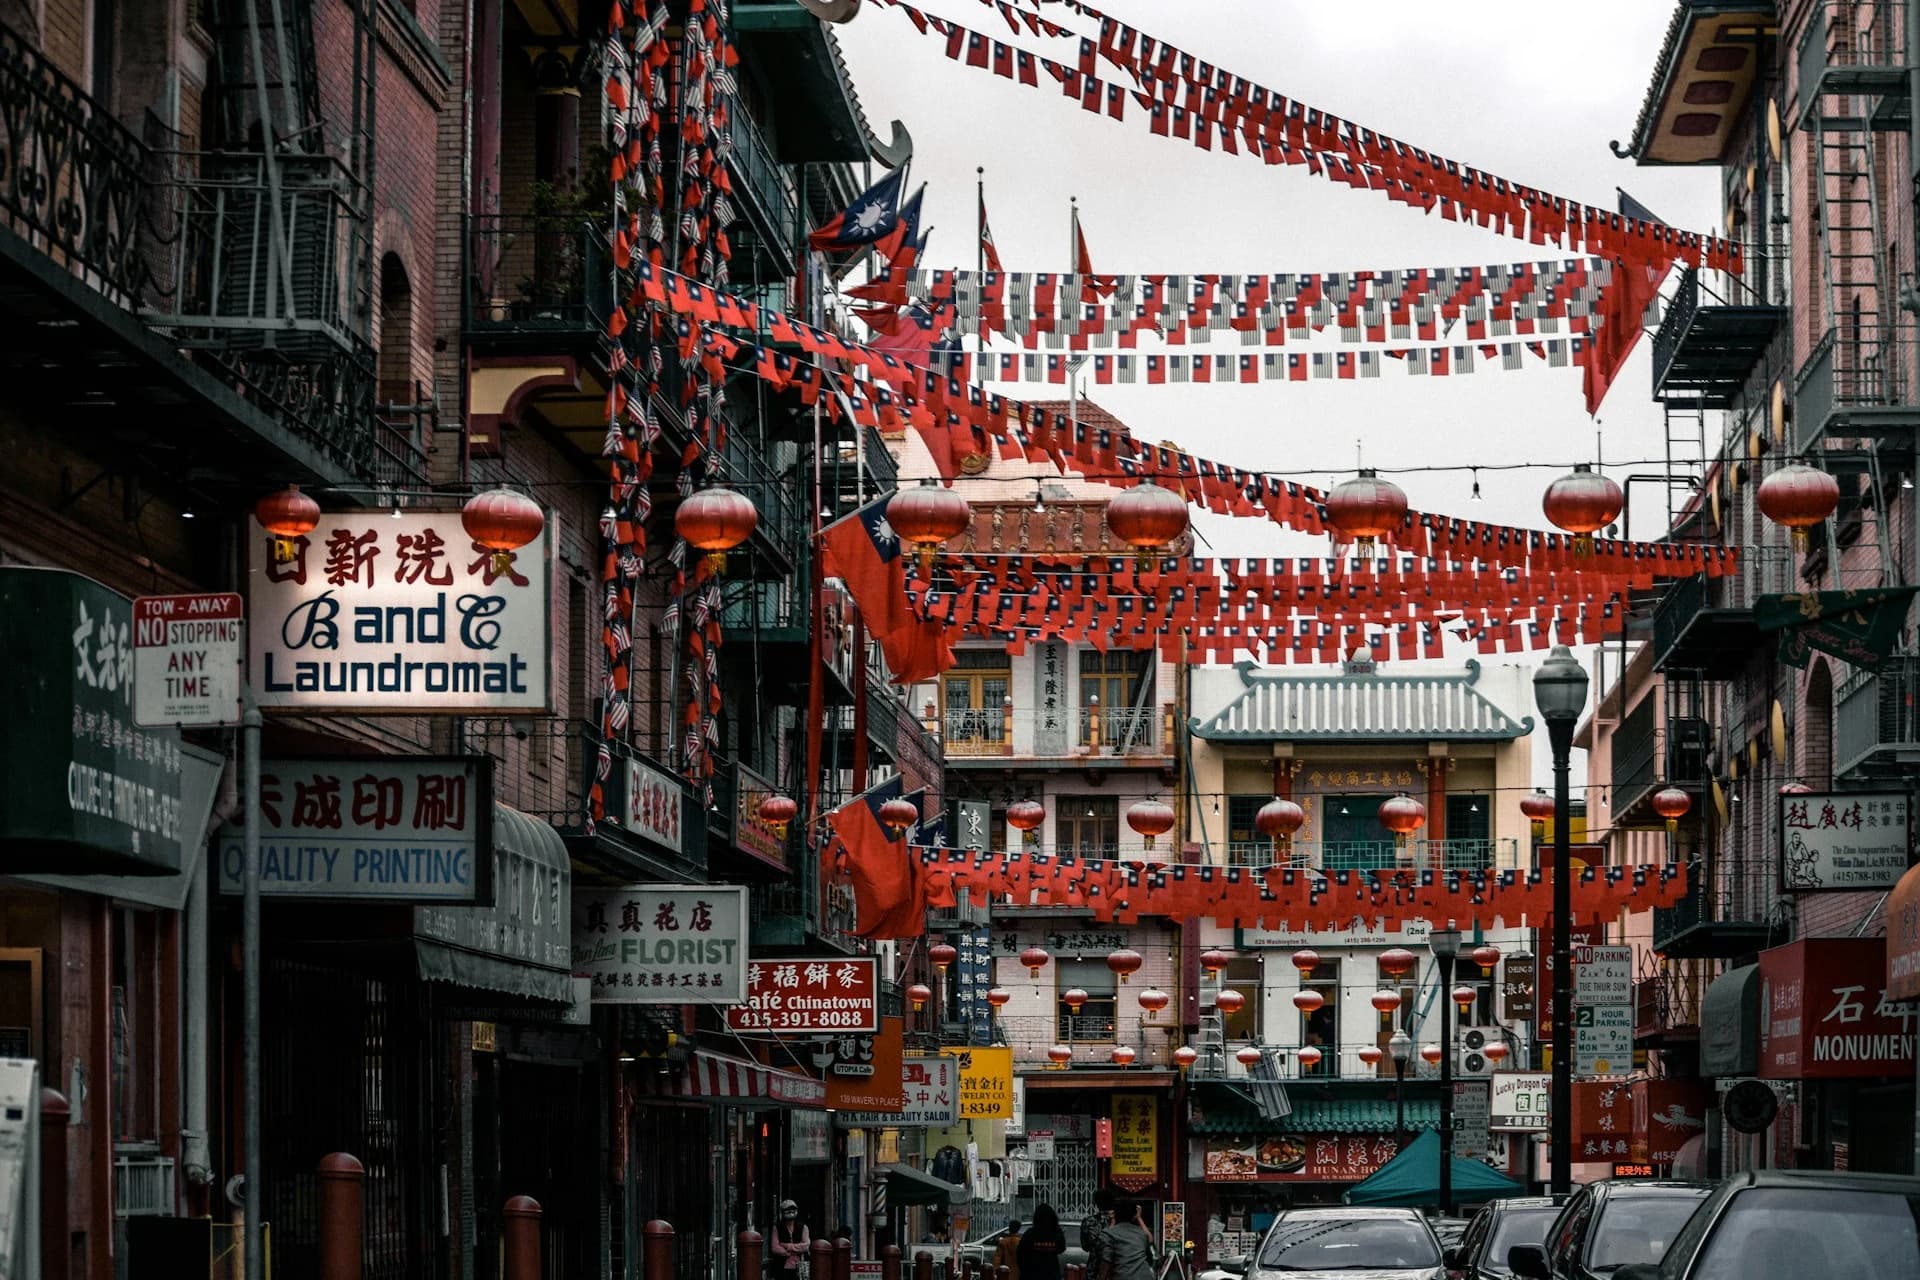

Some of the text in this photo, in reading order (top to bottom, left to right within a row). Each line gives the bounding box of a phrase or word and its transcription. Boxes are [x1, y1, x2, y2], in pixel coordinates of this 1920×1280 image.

[265, 529, 530, 589] 日新洗衣
[282, 590, 506, 650] B and C
[138, 618, 237, 646] NO STOPPING
[168, 650, 208, 672] ANY
[265, 653, 528, 693] Laundromat
[165, 676, 211, 698] TIME
[222, 845, 473, 884] QUALITY PRINTING
[584, 900, 713, 933] 真真花店
[621, 939, 737, 965] FLORIST
[1576, 948, 1630, 963] NO PARKING
[1580, 967, 1587, 977] 2
[1606, 967, 1613, 978] 6
[1579, 982, 1627, 992] TUE THUR SUN
[786, 995, 873, 1010] Chinatown
[740, 1011, 863, 1028] 415-391-8088
[1580, 1010, 1624, 1025] 2 HOUR
[1596, 1019, 1630, 1027] PARKING
[1580, 1030, 1586, 1041] 8
[1610, 1030, 1617, 1041] 9
[1579, 1044, 1598, 1052] MON
[1615, 1043, 1628, 1052] SAT
[1813, 1034, 1917, 1062] MONUMEN
[836, 1065, 858, 1073] UTOPIA
[1495, 1080, 1516, 1096] Lucky
[1516, 1078, 1540, 1091] Dragon
[851, 1095, 879, 1106] WAVERLY
[880, 1097, 900, 1107] PLACE
[890, 1111, 922, 1122] BEAUTY
[924, 1110, 951, 1122] SALON
[1313, 1166, 1356, 1174] HUNAN
